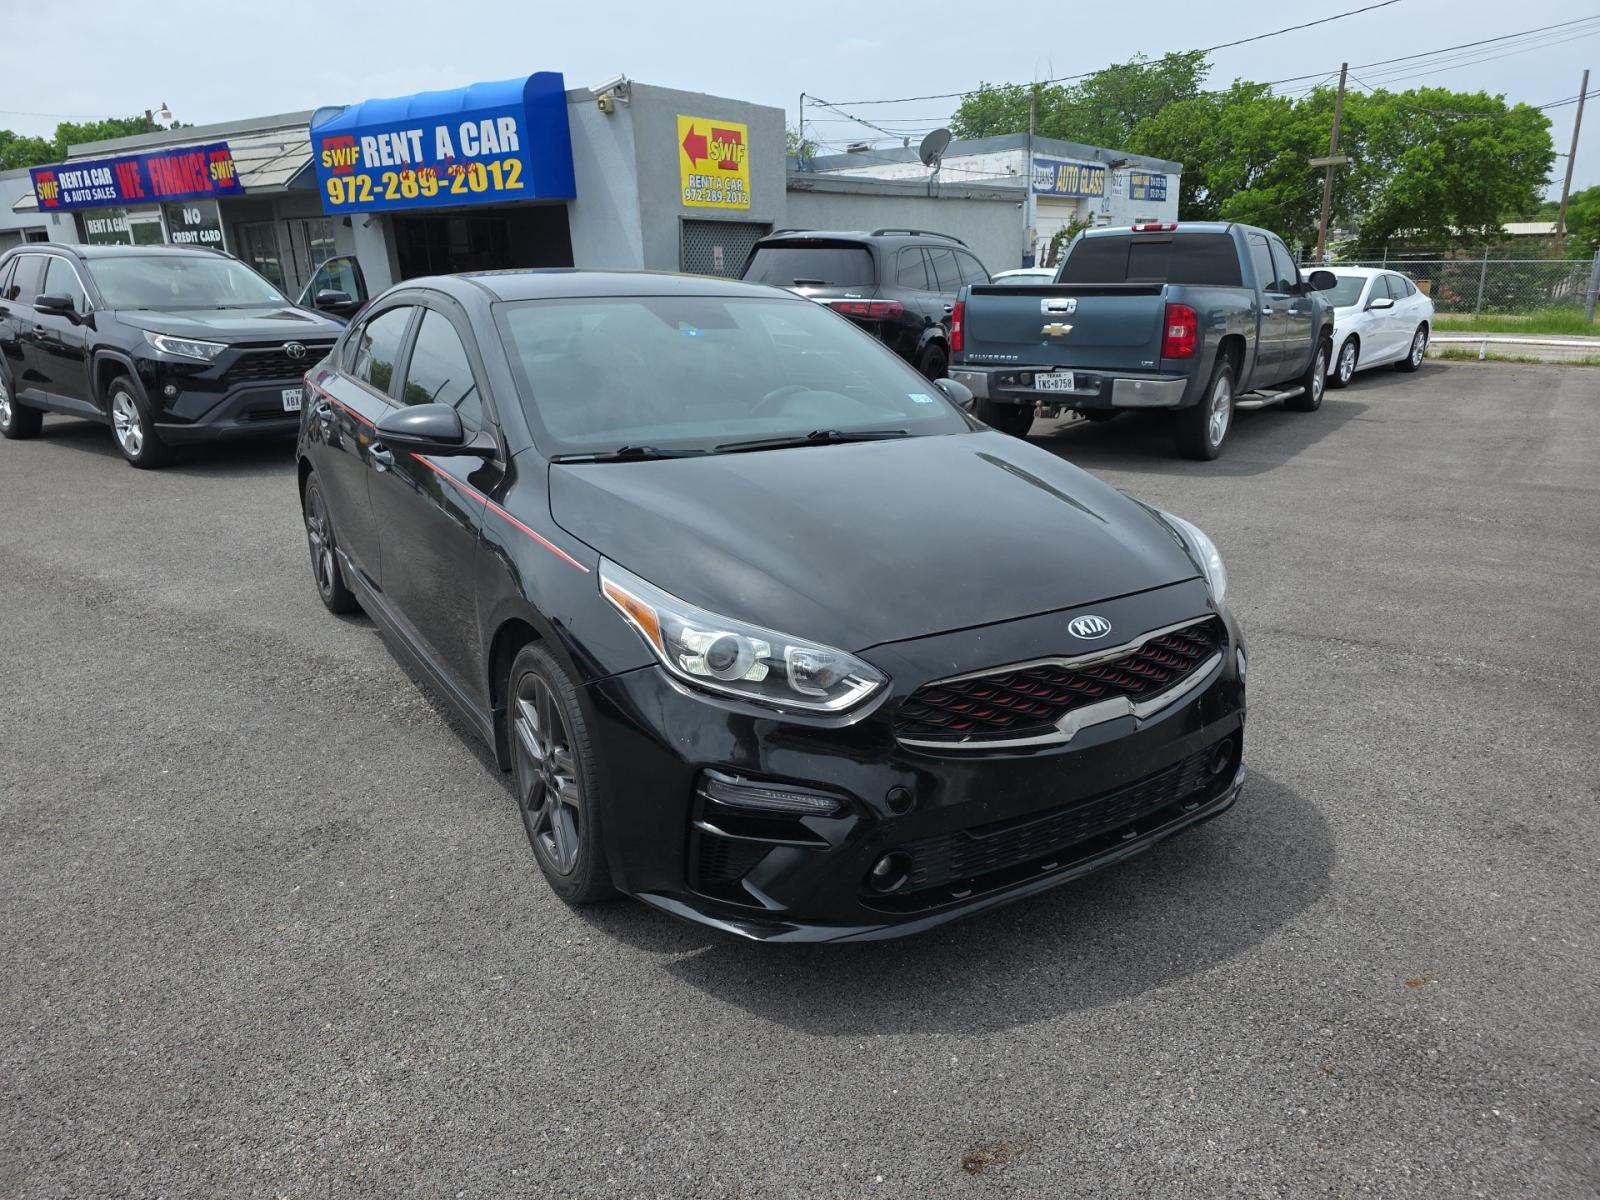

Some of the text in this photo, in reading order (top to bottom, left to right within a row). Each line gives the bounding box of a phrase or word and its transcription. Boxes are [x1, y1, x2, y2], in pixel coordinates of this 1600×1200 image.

[360, 129, 424, 169] RENT
[435, 125, 455, 160] A
[459, 116, 520, 157] CAR
[58, 167, 113, 190] RENT A CAR
[115, 152, 213, 198] WE FINANCE
[326, 158, 525, 205] 972-289-2012
[688, 174, 743, 191] RENT A CAR
[1056, 165, 1079, 193] AUTO
[1080, 168, 1105, 195] GLASS
[64, 186, 116, 203] & AUTO SALES
[684, 188, 748, 204] 972-289-2012
[87, 217, 129, 234] RENT A CAR
[183, 208, 201, 225] NO
[172, 229, 221, 243] CREDIT CARD
[1073, 617, 1108, 636] KIA
